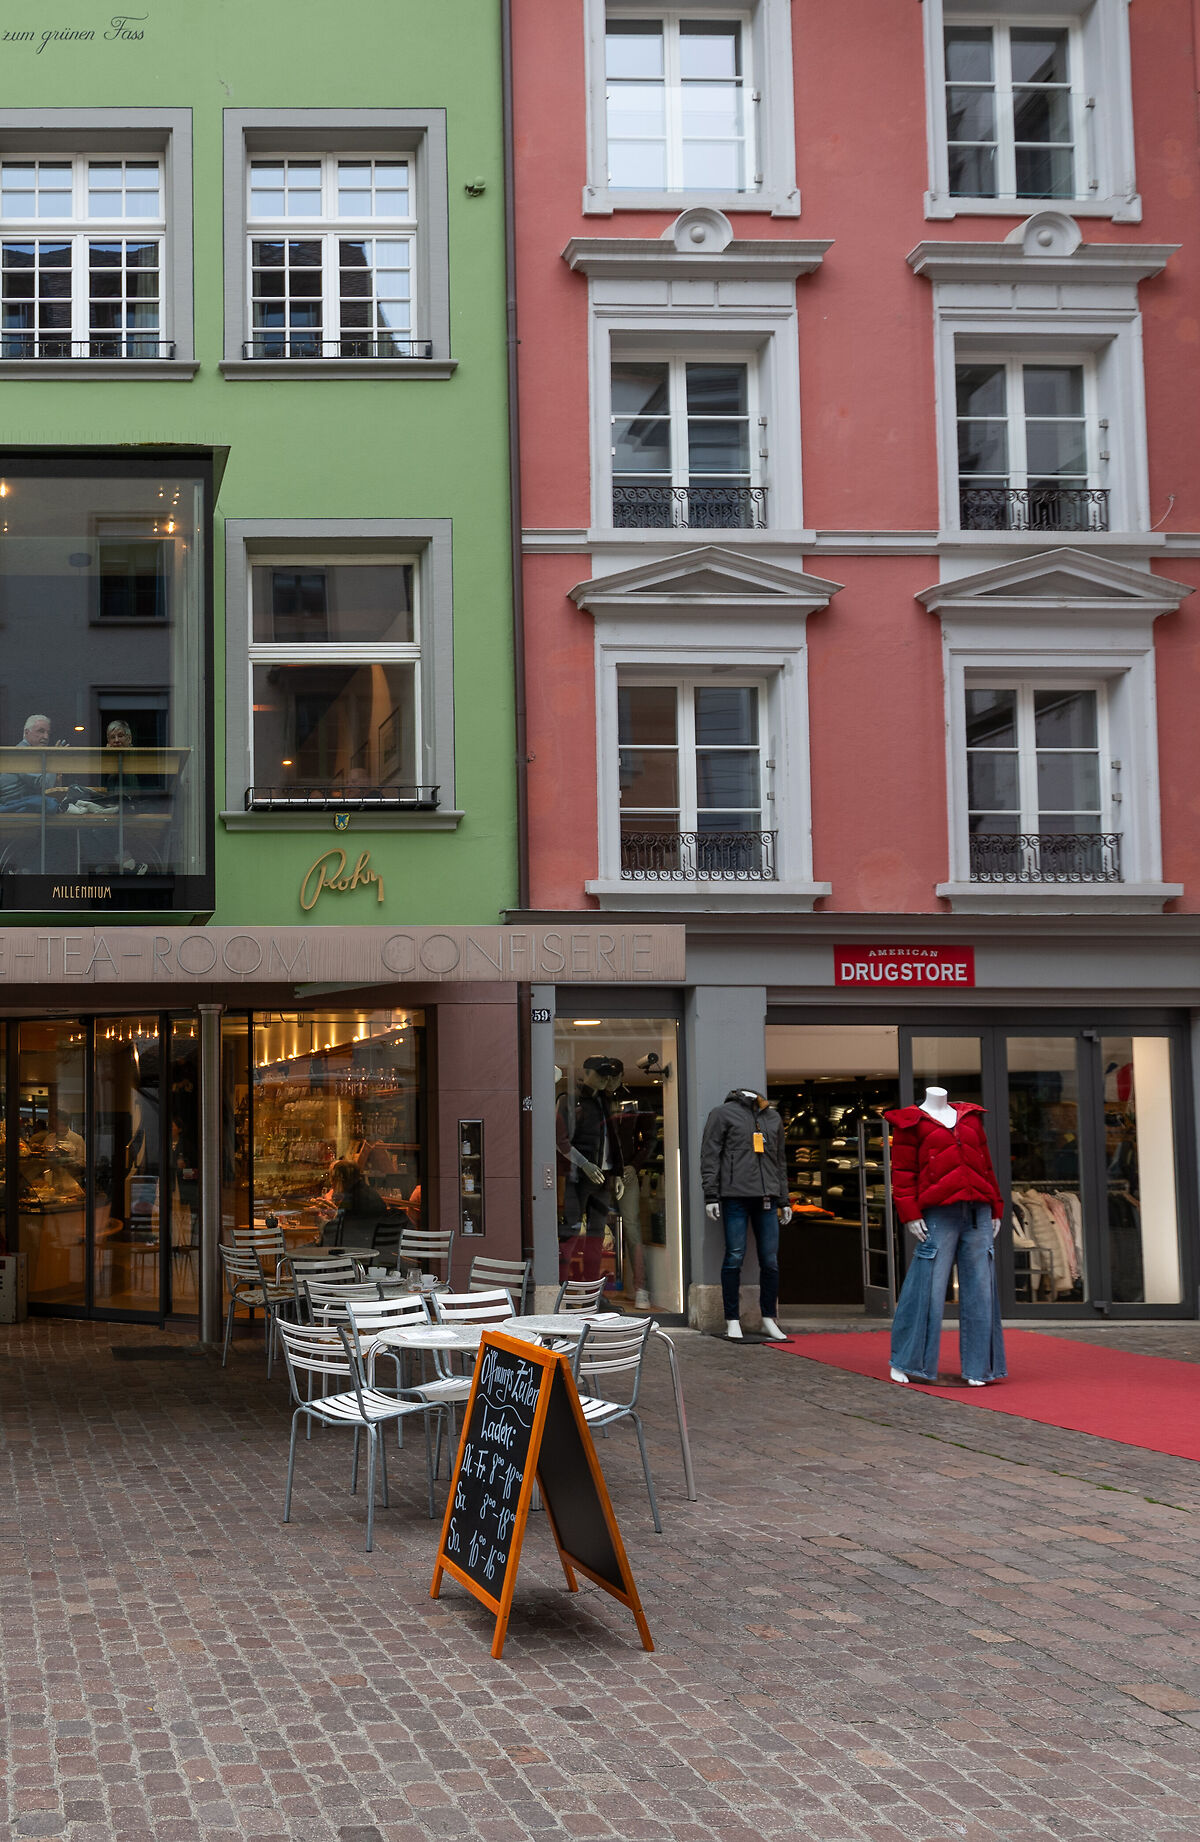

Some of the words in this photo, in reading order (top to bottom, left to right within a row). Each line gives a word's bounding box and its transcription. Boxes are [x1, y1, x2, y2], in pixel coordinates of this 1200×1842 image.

[1, 29, 35, 42] zum
[36, 27, 96, 55] grünen
[103, 12, 150, 42] Fass
[51, 885, 113, 900] MILLENNIUM
[380, 933, 653, 974] CONFISERIE
[868, 948, 939, 958] AMERICAN
[840, 962, 968, 982] DRUGSTORE
[534, 1009, 548, 1021] 59
[480, 1404, 517, 1451] Laden:
[455, 1481, 467, 1511] Sa.
[447, 1516, 461, 1553] So.
